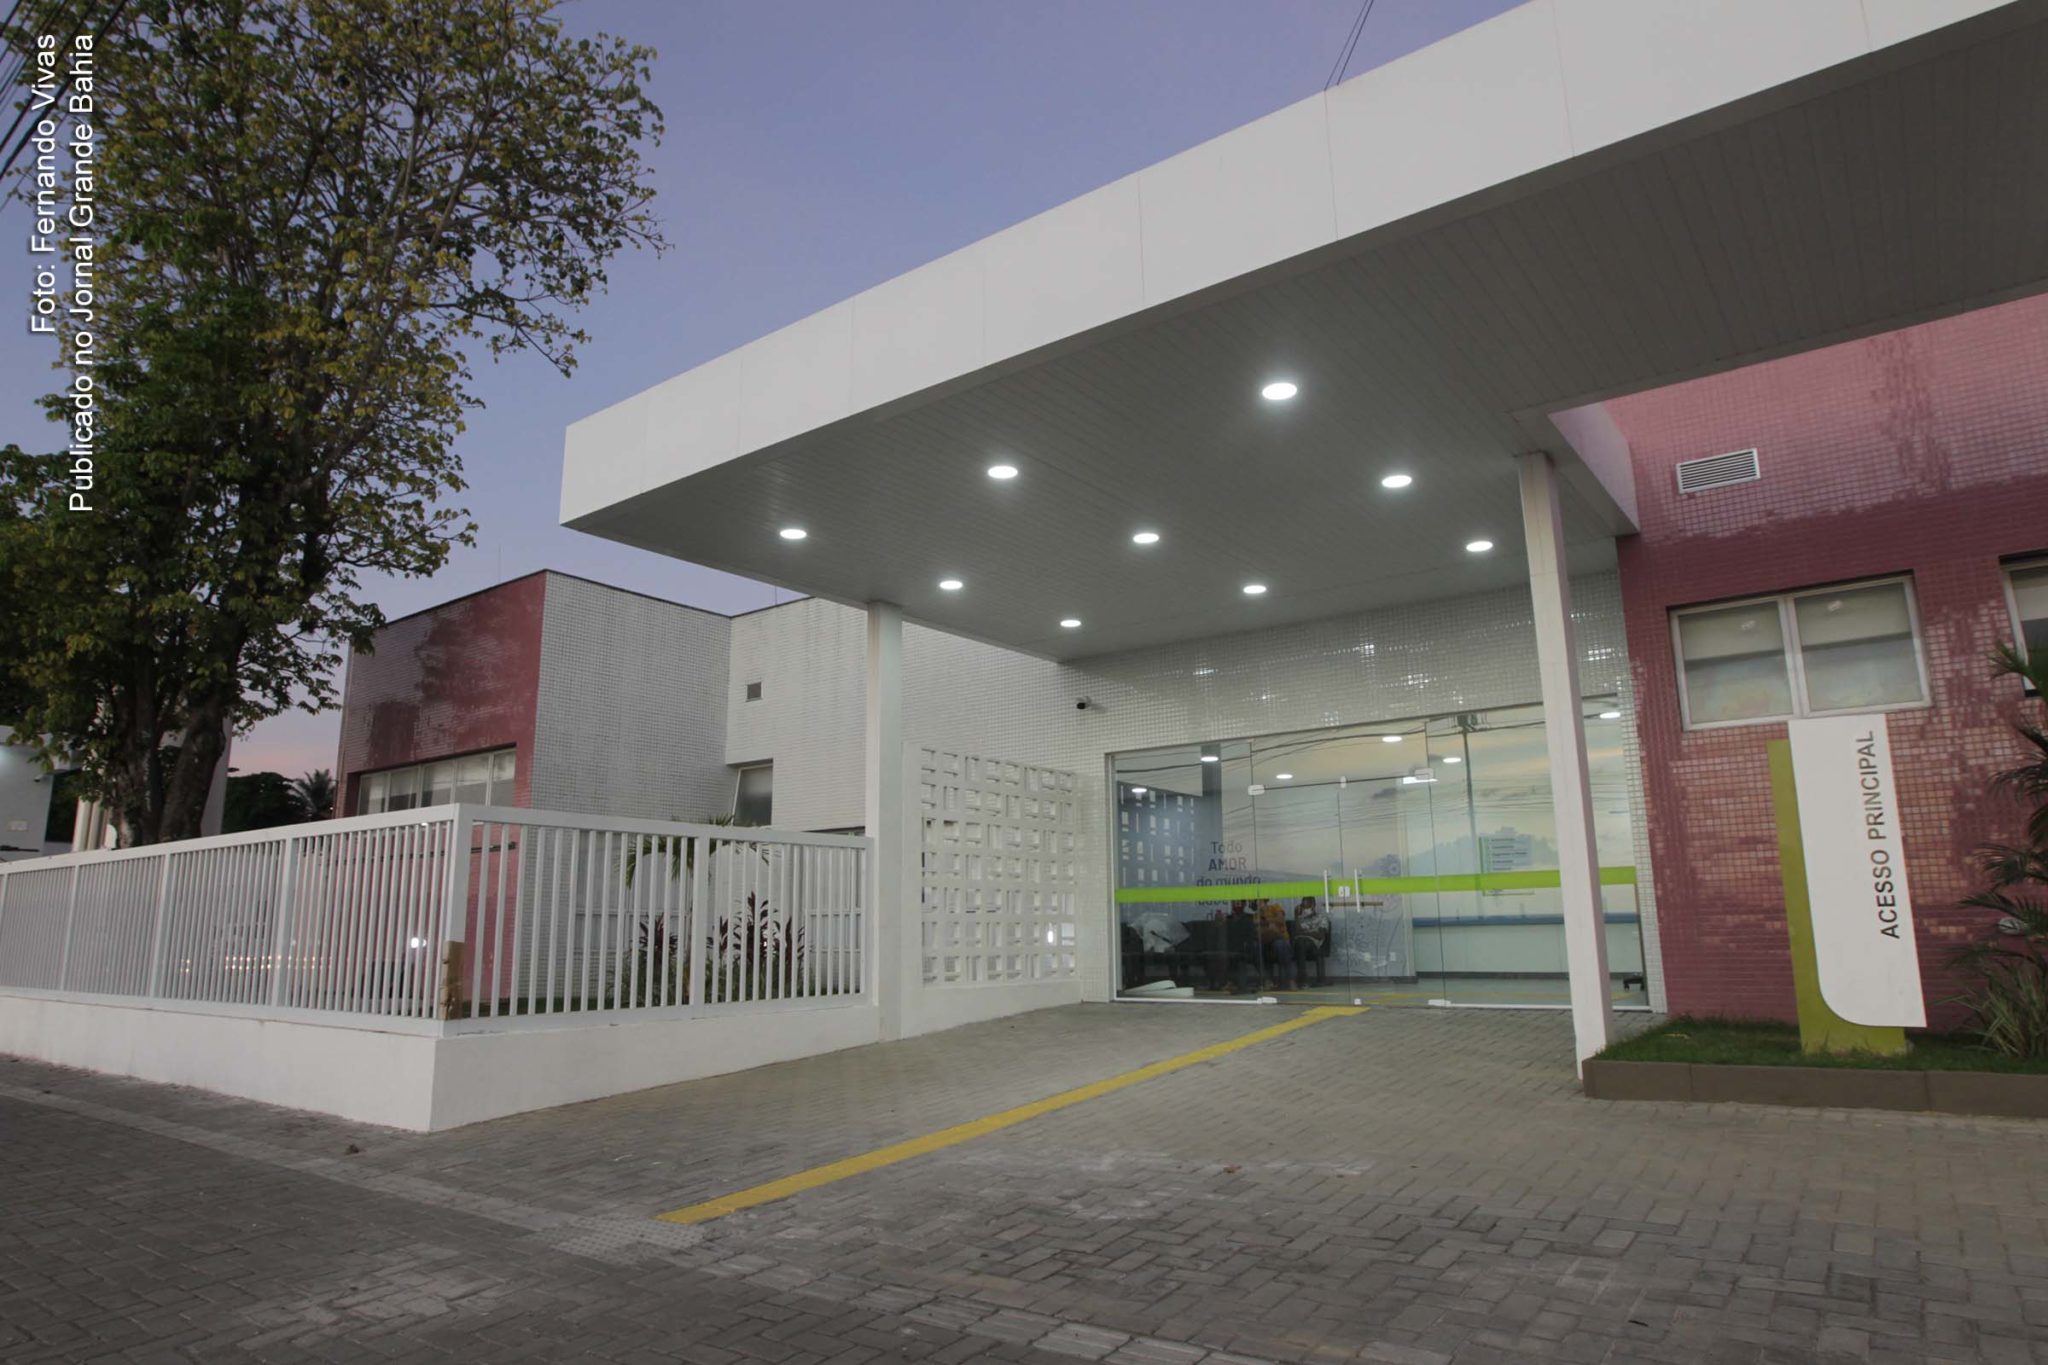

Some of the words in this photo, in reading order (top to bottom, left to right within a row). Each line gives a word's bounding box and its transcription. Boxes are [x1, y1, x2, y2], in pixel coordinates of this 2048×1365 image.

[1856, 730, 1887, 839] PRINCIPAL
[1208, 857, 1247, 871] AMOR
[1211, 841, 1242, 854] Todo
[1870, 849, 1900, 939] ACESSO
